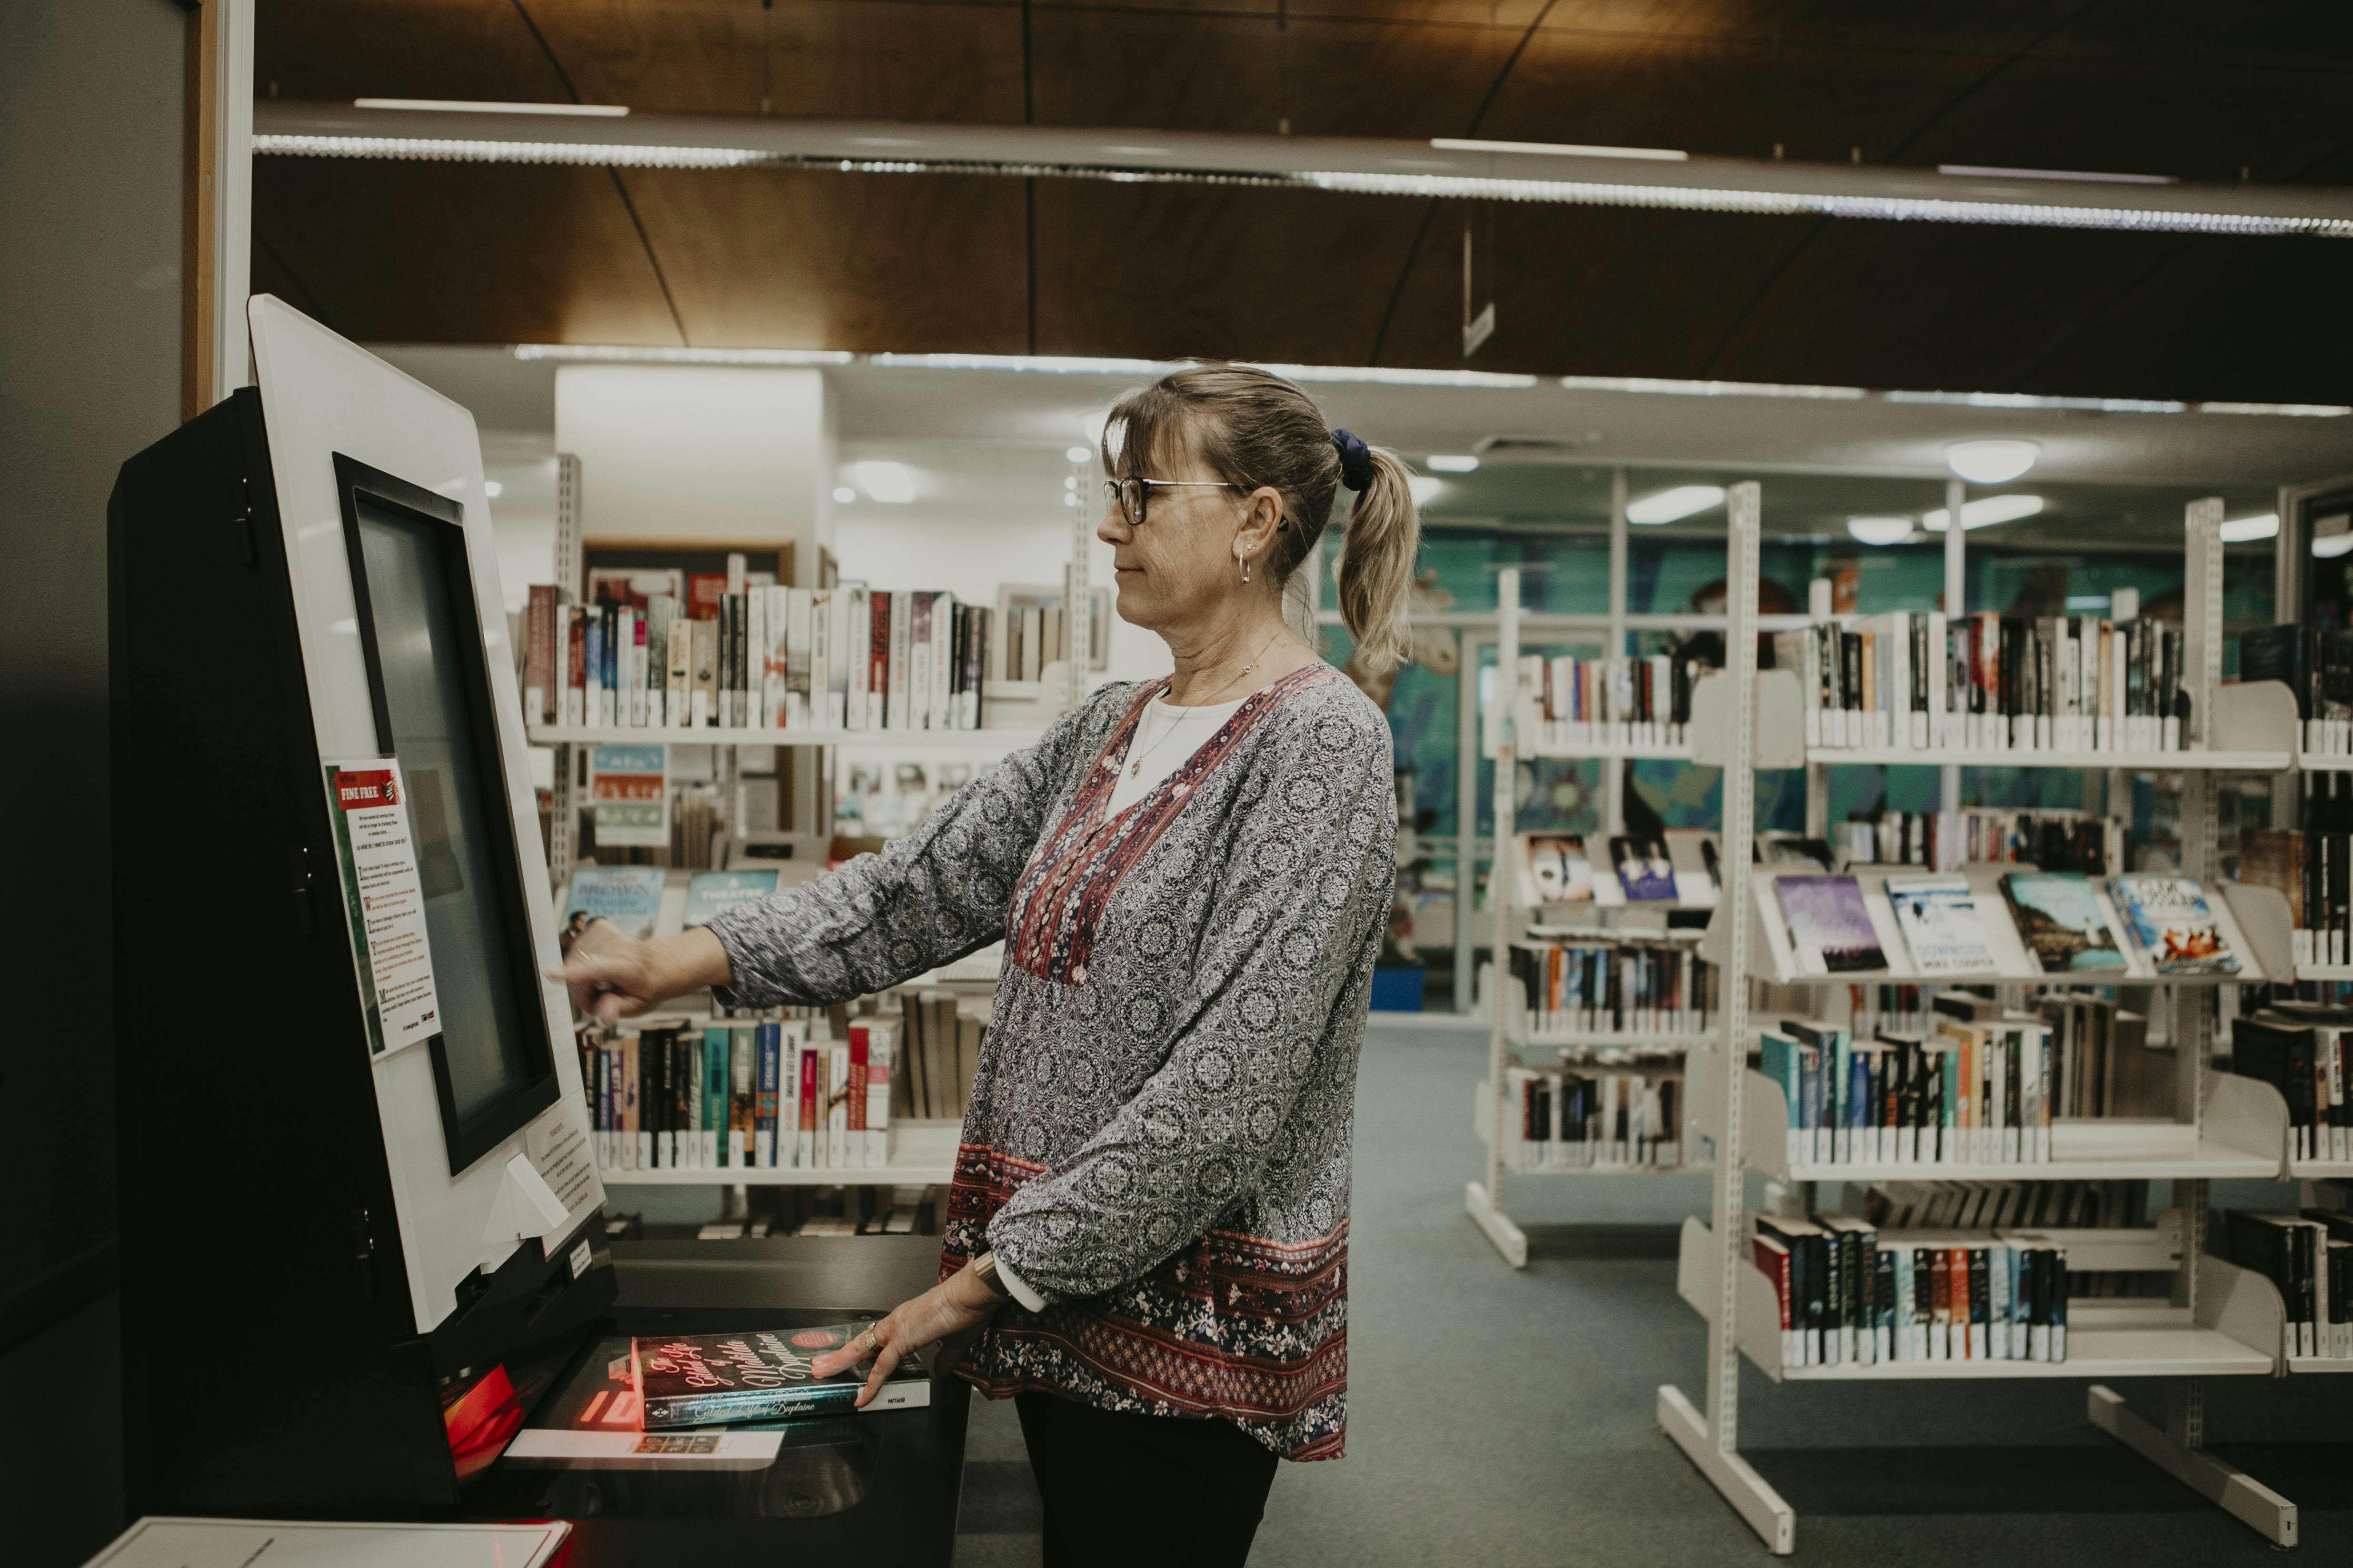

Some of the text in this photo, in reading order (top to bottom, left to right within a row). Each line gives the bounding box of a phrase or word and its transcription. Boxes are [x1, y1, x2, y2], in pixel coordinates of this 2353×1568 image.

[340, 786, 378, 800] FINE FREE
[578, 883, 650, 896] BROWN
[701, 889, 765, 900] THEATRE
[765, 1052, 774, 1089] BURKE
[787, 1061, 795, 1072] LEE
[786, 1075, 794, 1098] BURKE
[1864, 1245, 1874, 1265] LEE
[649, 1357, 680, 1373] The
[660, 1342, 735, 1388] Gilded Life
[717, 1340, 786, 1388] Matilda
[756, 1333, 812, 1379] Duplaine
[693, 1404, 731, 1423] Gilded
[731, 1400, 762, 1419] Life
[771, 1402, 815, 1415] Duplaine
